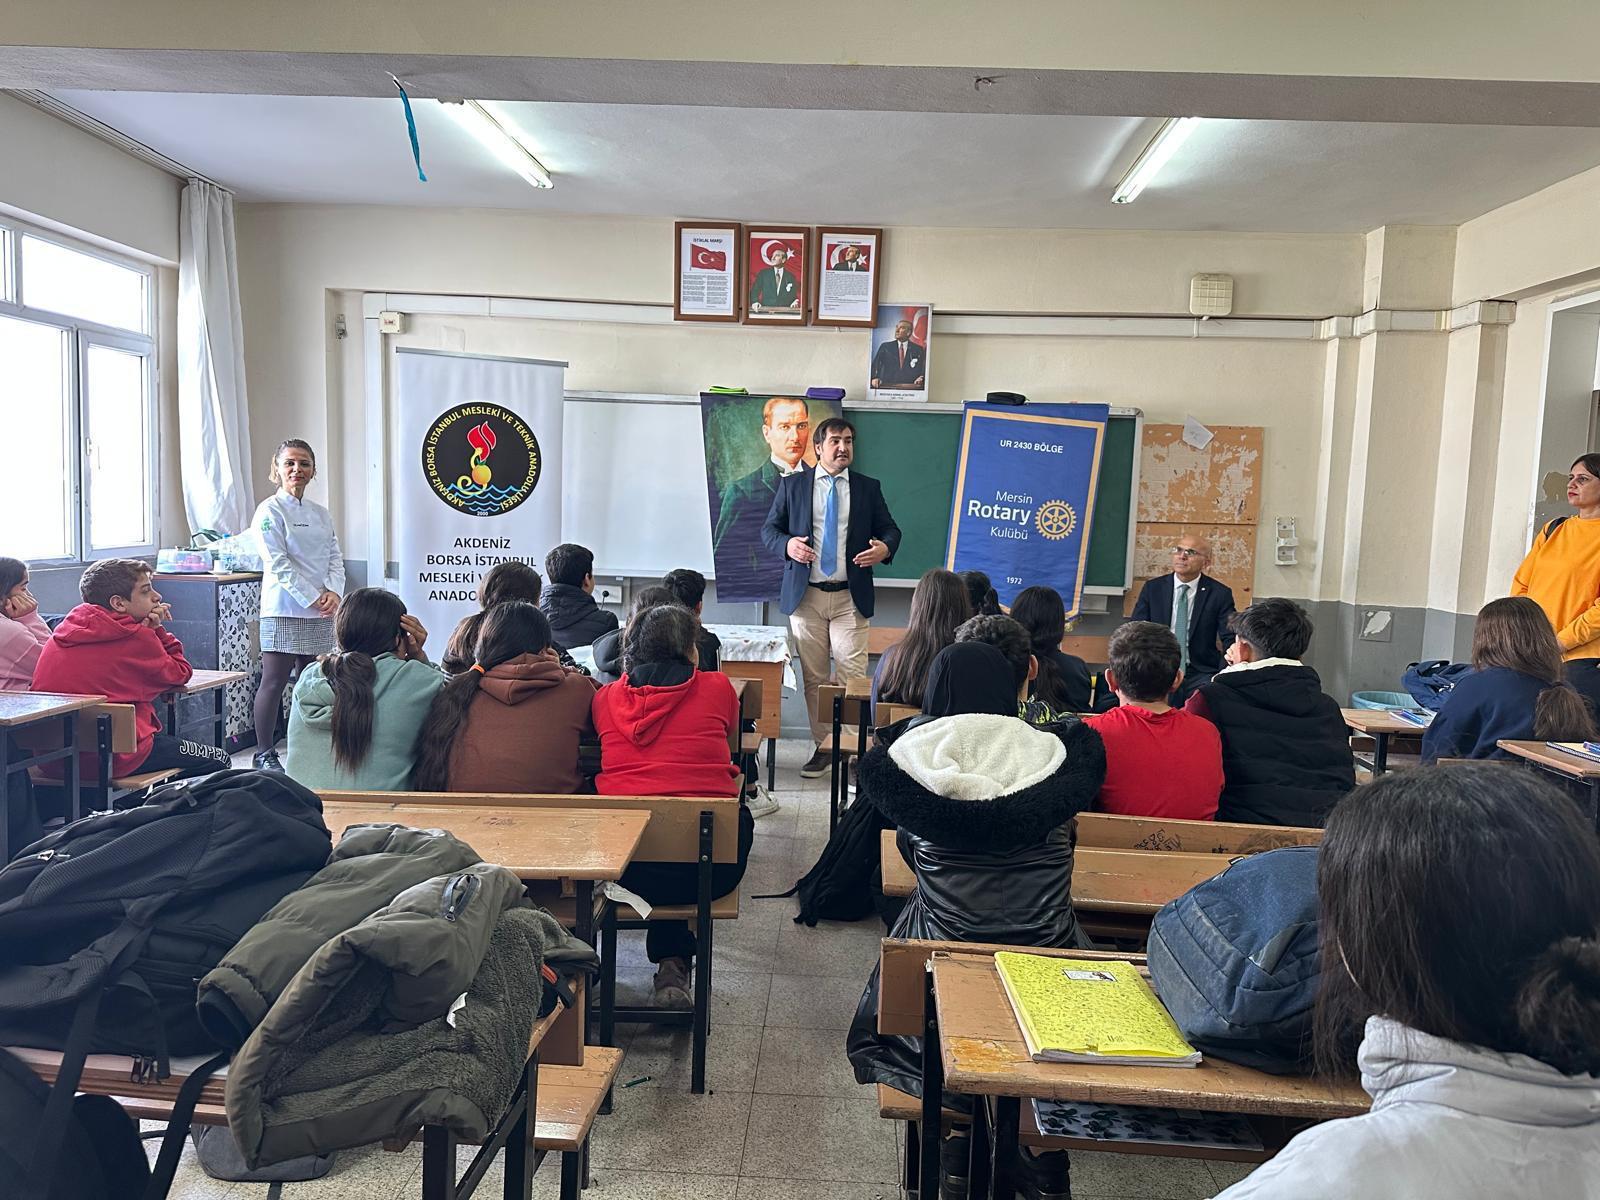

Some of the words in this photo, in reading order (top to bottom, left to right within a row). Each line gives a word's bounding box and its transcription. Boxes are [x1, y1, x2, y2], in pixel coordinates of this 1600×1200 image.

[462, 406, 500, 418] MESLEKİ
[502, 411, 513, 424] VE
[427, 411, 461, 445] İSTANBUL
[512, 420, 535, 450] TEKNİK
[1000, 439, 1012, 448] UR
[1013, 441, 1032, 450] 2430
[1034, 442, 1064, 454] BÖLGE
[427, 446, 437, 477] BORSA
[521, 451, 537, 493] ANADOLU
[433, 478, 464, 507] AKDENİZ
[995, 490, 1033, 504] Mersin
[500, 491, 523, 510] LİSESİ
[967, 499, 1031, 526] Rotary
[990, 526, 1028, 540] Kulübü
[453, 536, 511, 549] AKDENİZ
[427, 554, 472, 566] BORSA
[419, 570, 475, 583] MESLEKİ
[1006, 576, 1023, 585] 1972
[428, 590, 478, 601] ANADO
